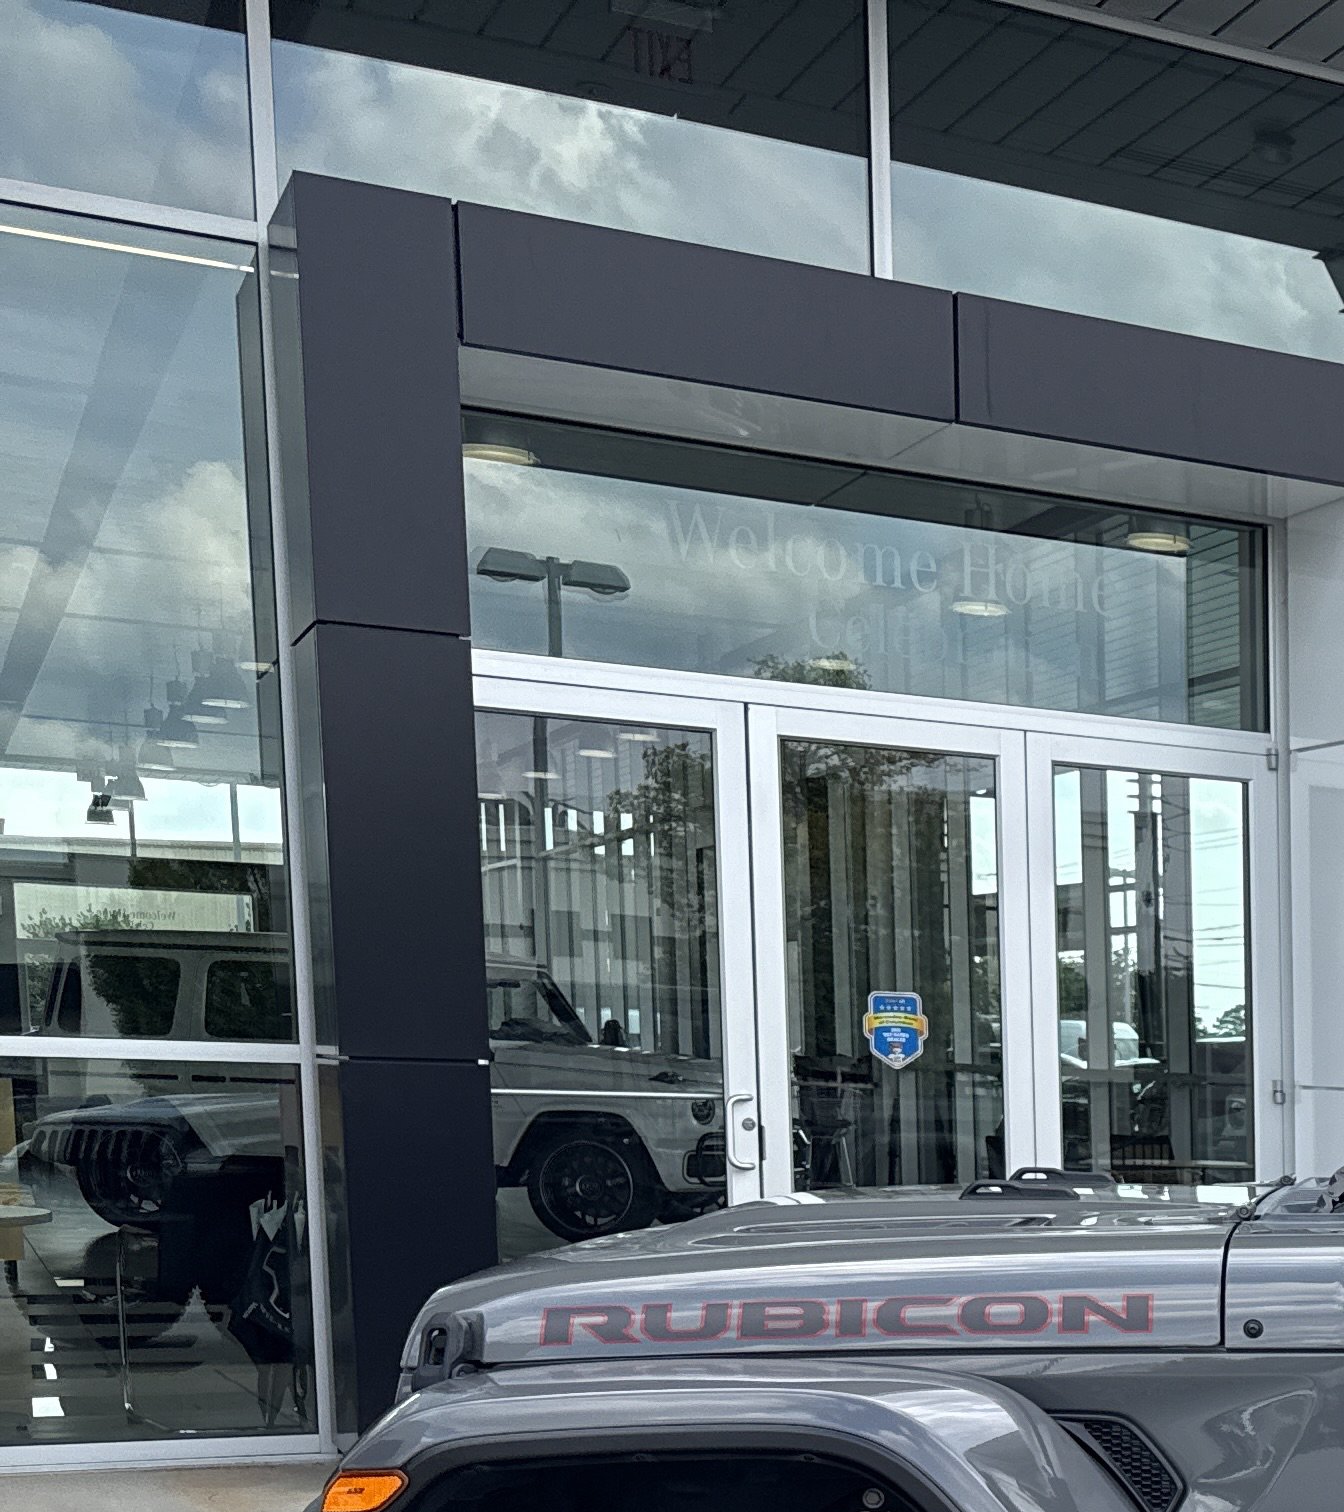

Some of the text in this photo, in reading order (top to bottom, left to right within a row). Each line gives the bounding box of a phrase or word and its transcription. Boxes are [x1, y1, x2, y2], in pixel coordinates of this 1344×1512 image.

[665, 498, 1110, 618] Welcome Home
[538, 1292, 1155, 1346] RUBICON
